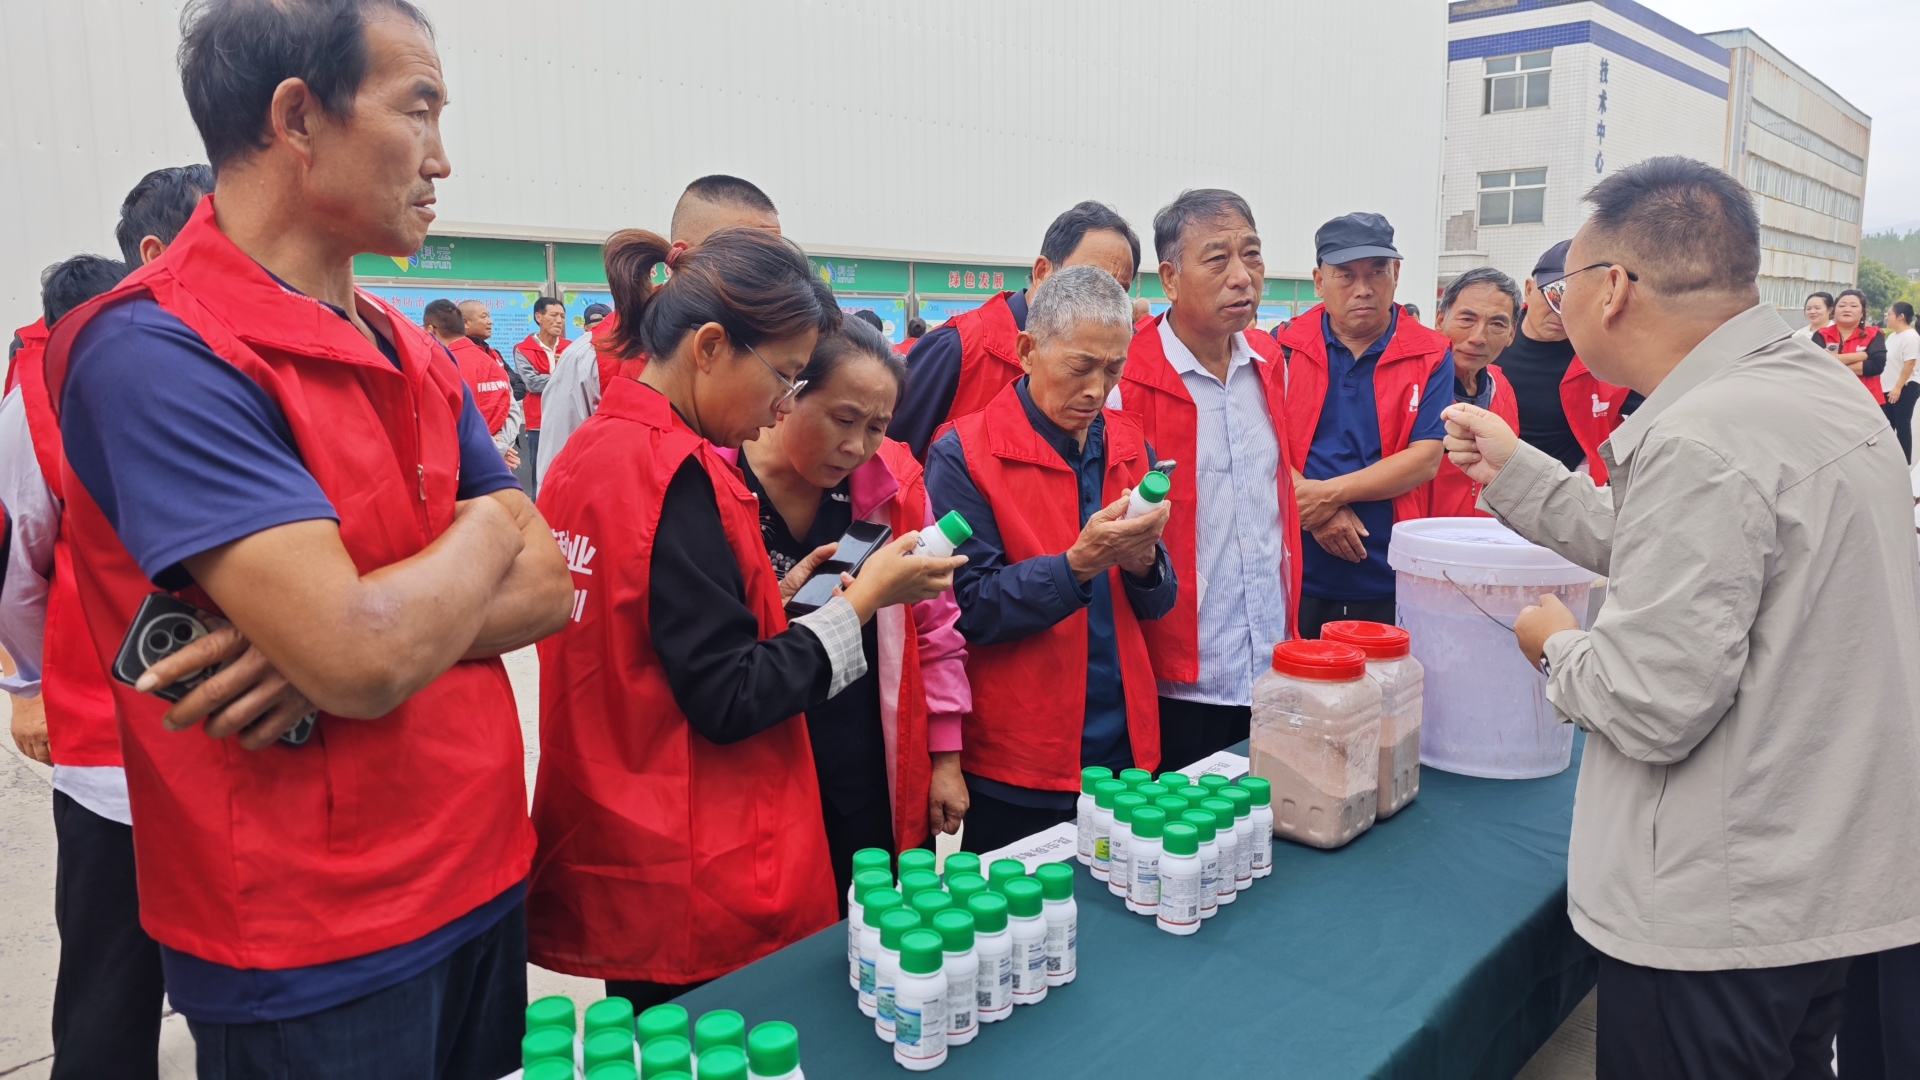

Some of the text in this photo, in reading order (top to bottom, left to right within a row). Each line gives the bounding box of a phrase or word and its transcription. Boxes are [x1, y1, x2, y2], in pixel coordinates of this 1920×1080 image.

[1594, 57, 1609, 174] 技术中心
[421, 245, 451, 261] 科云
[421, 261, 452, 270] KEYUN
[948, 270, 1005, 290] 绿色发展
